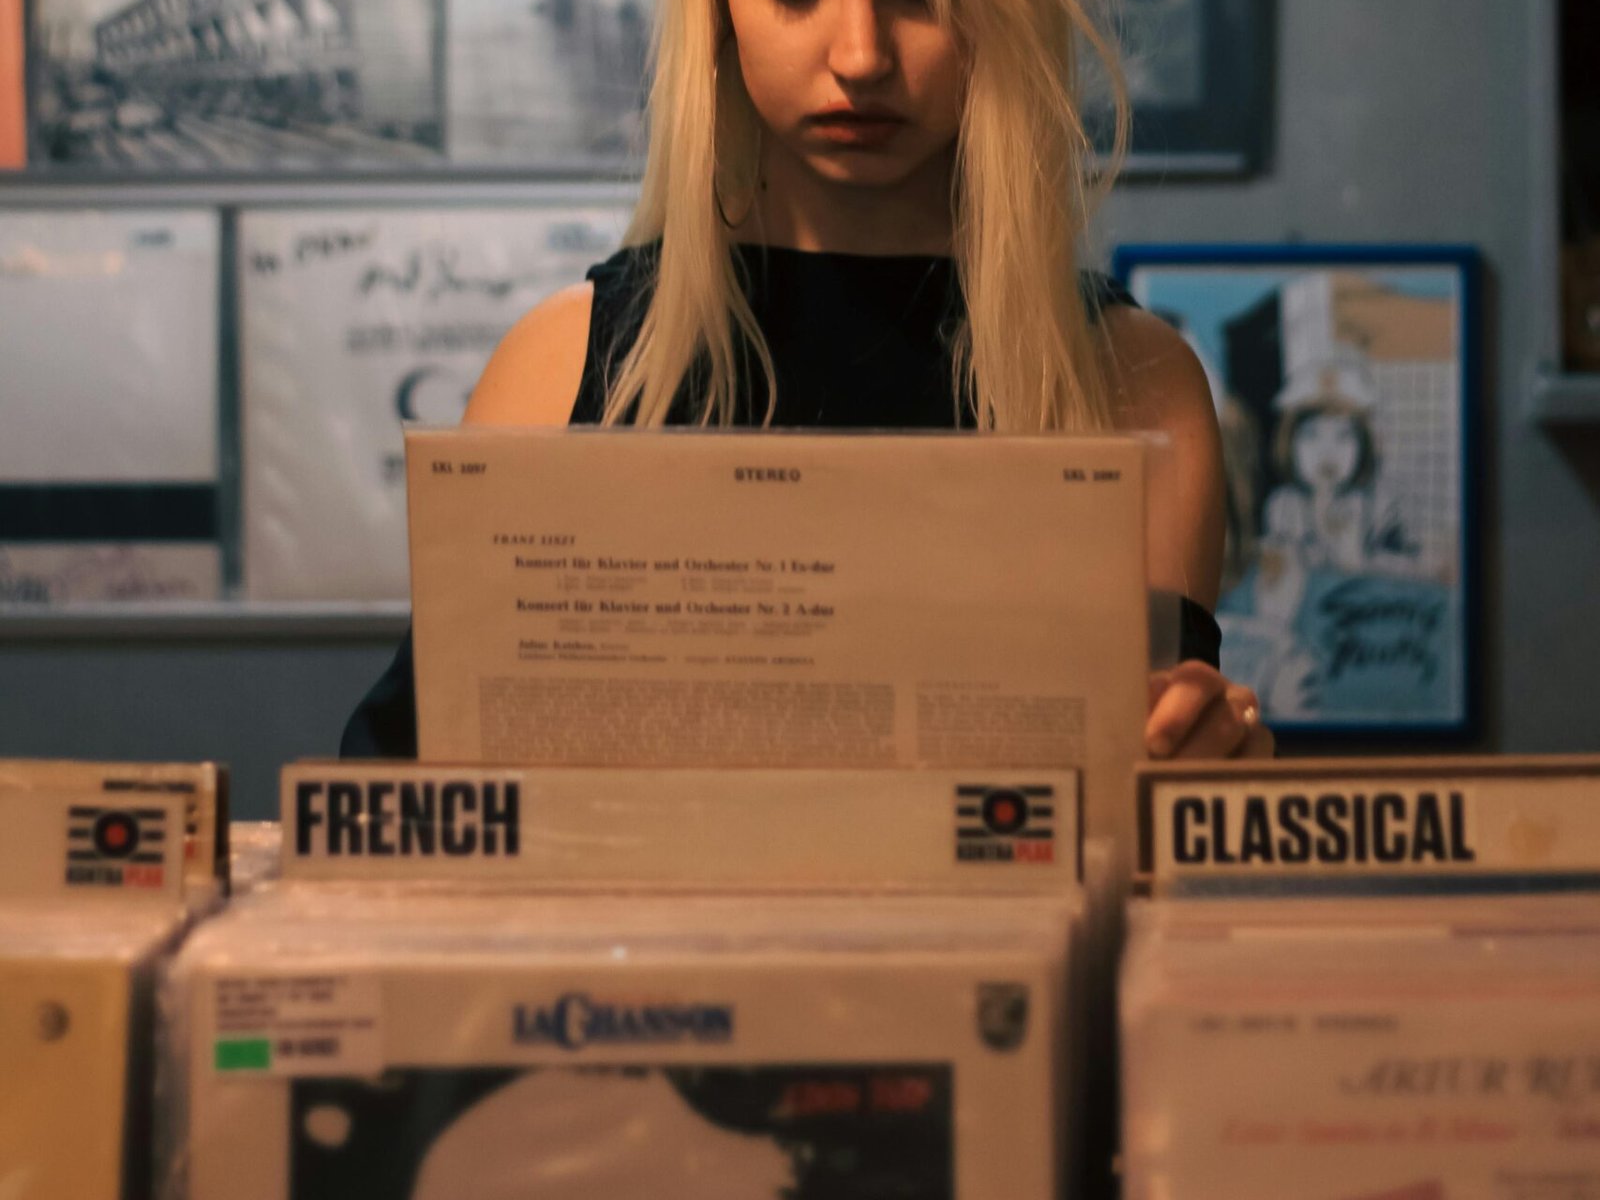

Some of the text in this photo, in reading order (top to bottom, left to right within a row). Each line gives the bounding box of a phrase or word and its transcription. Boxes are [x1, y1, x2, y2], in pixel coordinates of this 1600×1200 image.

[734, 467, 802, 483] STEREO
[493, 533, 576, 546] FRANZ LISZT
[514, 554, 567, 571] Konzert
[571, 556, 592, 571] für
[597, 556, 648, 572] Klavier
[654, 558, 680, 572] und
[684, 558, 749, 573] Orchester
[516, 597, 569, 613] Konzert
[573, 599, 594, 613] für
[598, 599, 651, 614] Klavier
[655, 601, 681, 615] und
[686, 601, 751, 616] Orchester
[296, 781, 520, 857] FRENCH
[1172, 792, 1476, 864] CLASSICAL
